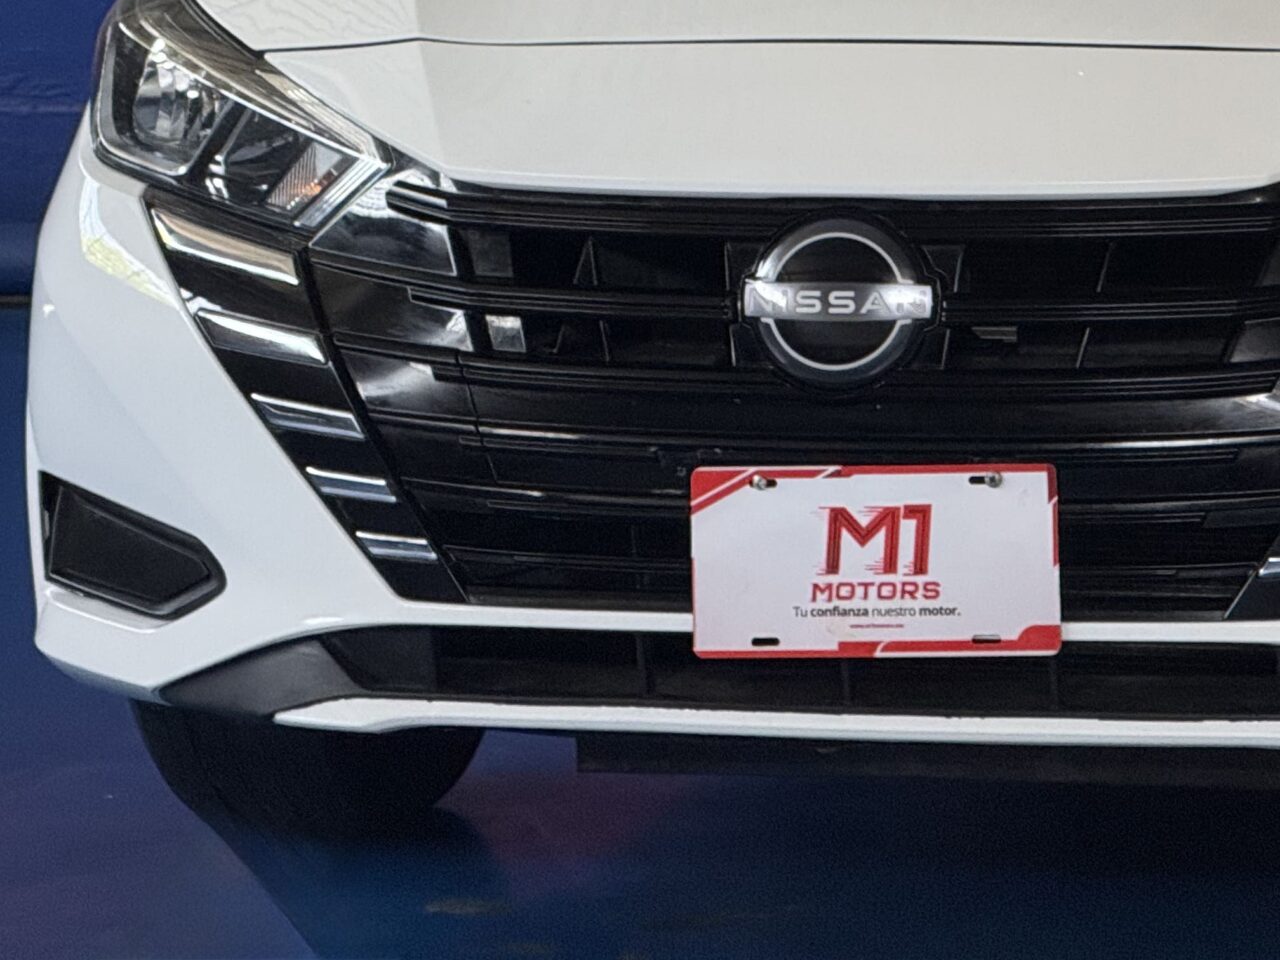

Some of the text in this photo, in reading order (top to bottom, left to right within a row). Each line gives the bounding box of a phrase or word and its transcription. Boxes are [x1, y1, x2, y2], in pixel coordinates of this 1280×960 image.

[749, 289, 929, 315] NISSAN
[817, 503, 933, 577] M1
[810, 581, 942, 604] MOTORS
[793, 606, 962, 618] Tu confianza nuestro motor.
